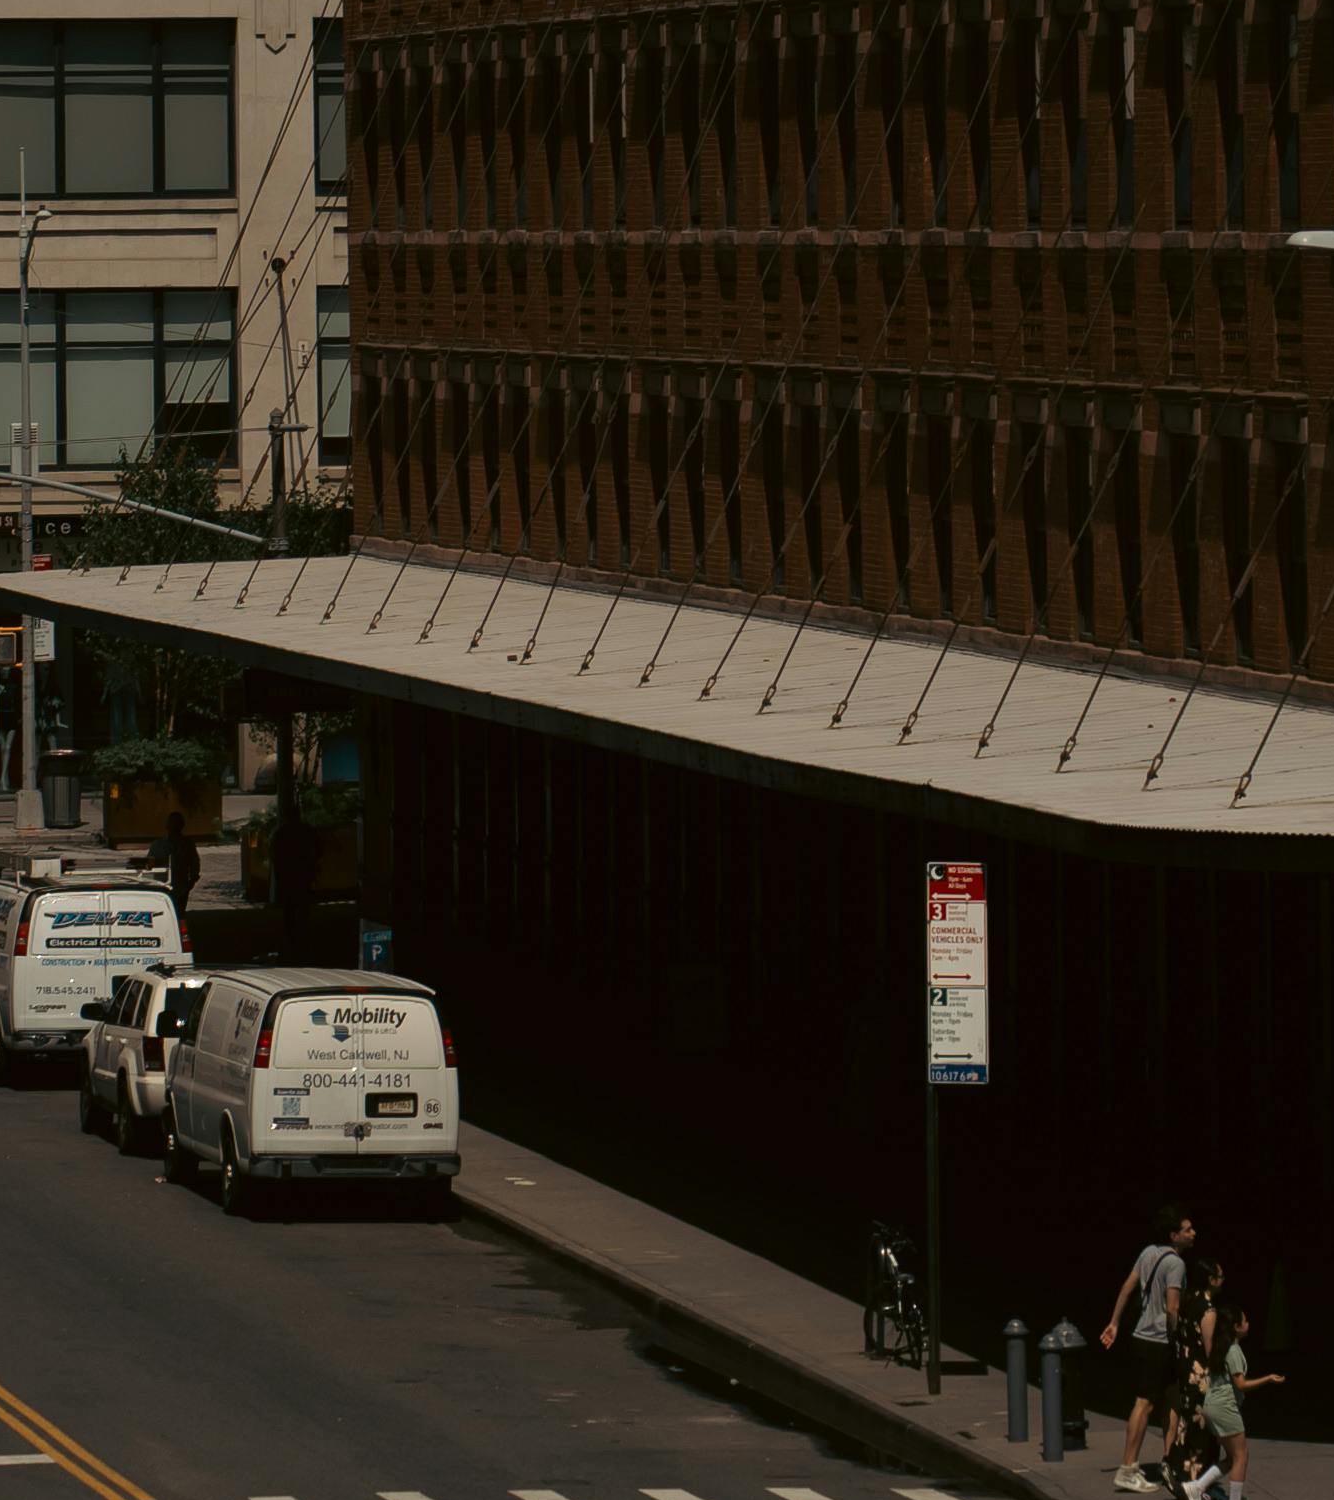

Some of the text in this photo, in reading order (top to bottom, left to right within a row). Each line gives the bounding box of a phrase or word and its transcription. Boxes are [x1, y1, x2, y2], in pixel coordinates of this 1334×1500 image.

[932, 903, 942, 919] 3
[52, 912, 153, 929] DELTA
[931, 926, 977, 935] COMMERCIAL
[49, 938, 157, 948] Electrical Contracting
[966, 936, 983, 944] ONLY
[371, 944, 383, 961] P
[932, 989, 943, 1006] 2
[333, 1008, 407, 1028] Mobility
[307, 1050, 336, 1061] West
[394, 1050, 410, 1061] NJ
[302, 1073, 411, 1088] 800-441-4181
[931, 1070, 966, 1082] 106176
[426, 1103, 439, 1113] 86
